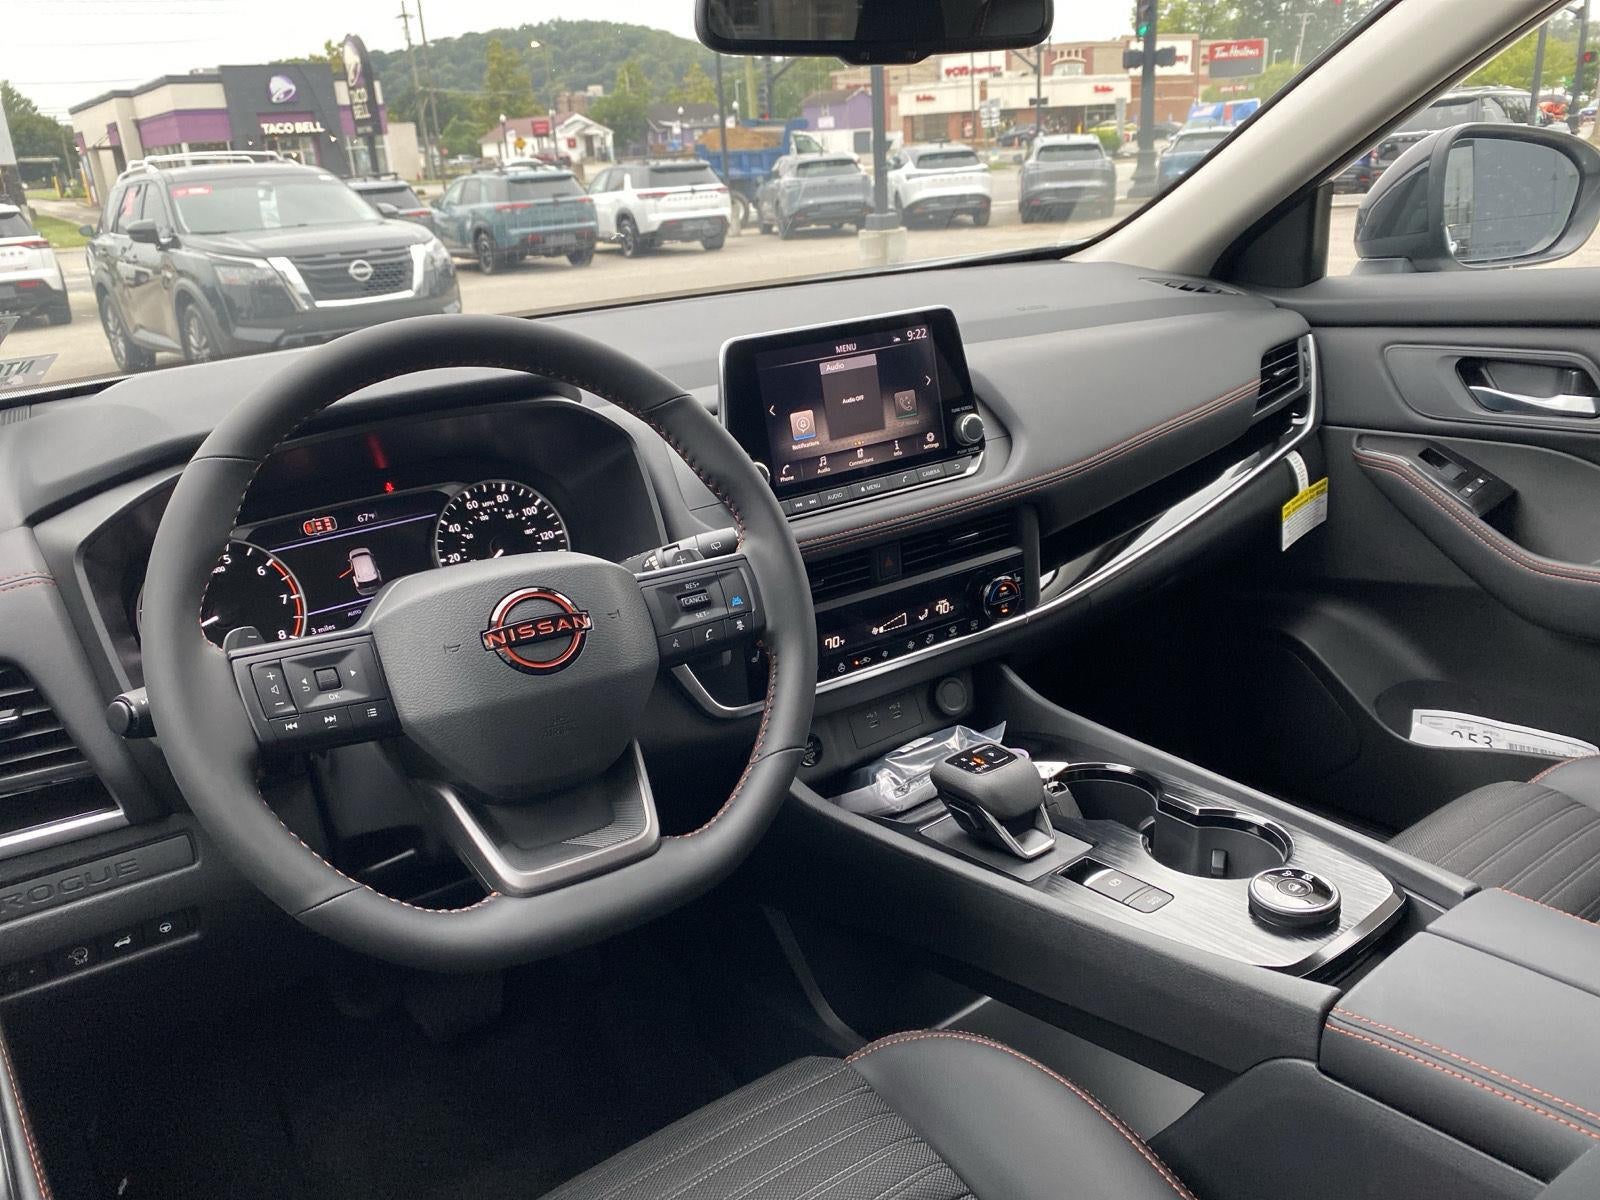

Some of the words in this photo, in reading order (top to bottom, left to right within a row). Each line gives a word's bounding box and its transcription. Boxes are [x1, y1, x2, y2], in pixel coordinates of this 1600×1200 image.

[1215, 46, 1228, 58] Tim
[1229, 44, 1259, 57] Hortons
[350, 88, 368, 104] TACO
[353, 103, 371, 120] BELL
[261, 122, 292, 134] TACO
[294, 121, 325, 134] BELL
[907, 328, 927, 341] 9:22
[835, 343, 857, 354] MENU
[826, 361, 845, 372] Audio
[842, 397, 855, 405] Audio
[855, 394, 865, 403] OFF
[792, 440, 820, 451] Notifications
[923, 441, 940, 451] Settings
[848, 457, 875, 468] Connections
[817, 466, 831, 475] Audio
[922, 467, 941, 478] CAMERA
[780, 474, 795, 483] Phone
[866, 482, 881, 492] MENU
[496, 493, 509, 504] 80
[827, 492, 843, 502] AUDIO
[466, 500, 479, 511] 60
[482, 500, 495, 508] MPH
[522, 506, 538, 518] 100
[448, 524, 461, 534] 40
[539, 530, 555, 541] 120
[223, 554, 231, 564] 5
[447, 552, 461, 564] 20
[257, 565, 265, 577] 6
[279, 594, 288, 605] 7
[347, 608, 362, 617] AUTO
[277, 629, 287, 640] 8
[310, 627, 317, 635] 3
[317, 624, 336, 634] miles
[485, 612, 591, 648] NISSAN
[328, 692, 341, 701] OK
[0, 858, 140, 914] ROGUE
